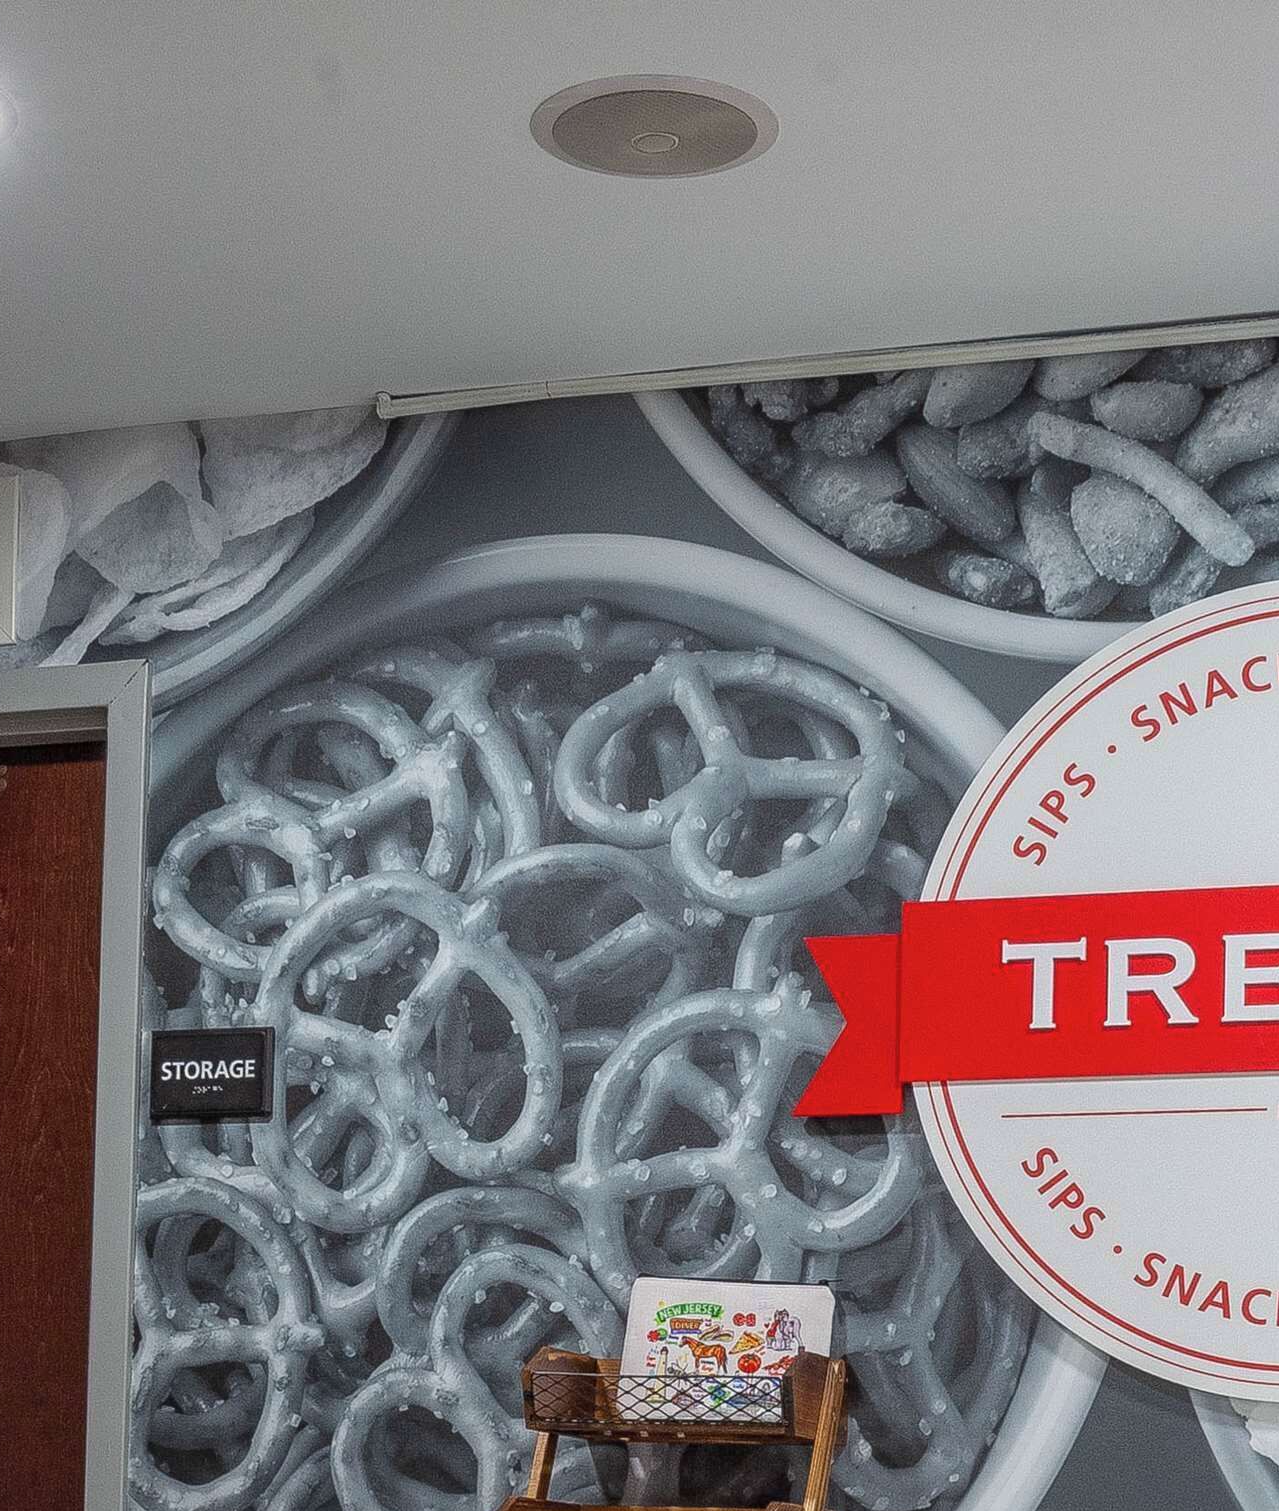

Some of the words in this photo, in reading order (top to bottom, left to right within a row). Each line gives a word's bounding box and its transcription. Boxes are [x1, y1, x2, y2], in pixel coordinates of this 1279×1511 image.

[1013, 765, 1095, 865] SIPS
[161, 1060, 255, 1081] STORAGE
[1021, 1147, 1105, 1240] SIPS
[658, 1305, 682, 1319] NEW
[683, 1303, 720, 1316] JERSEY
